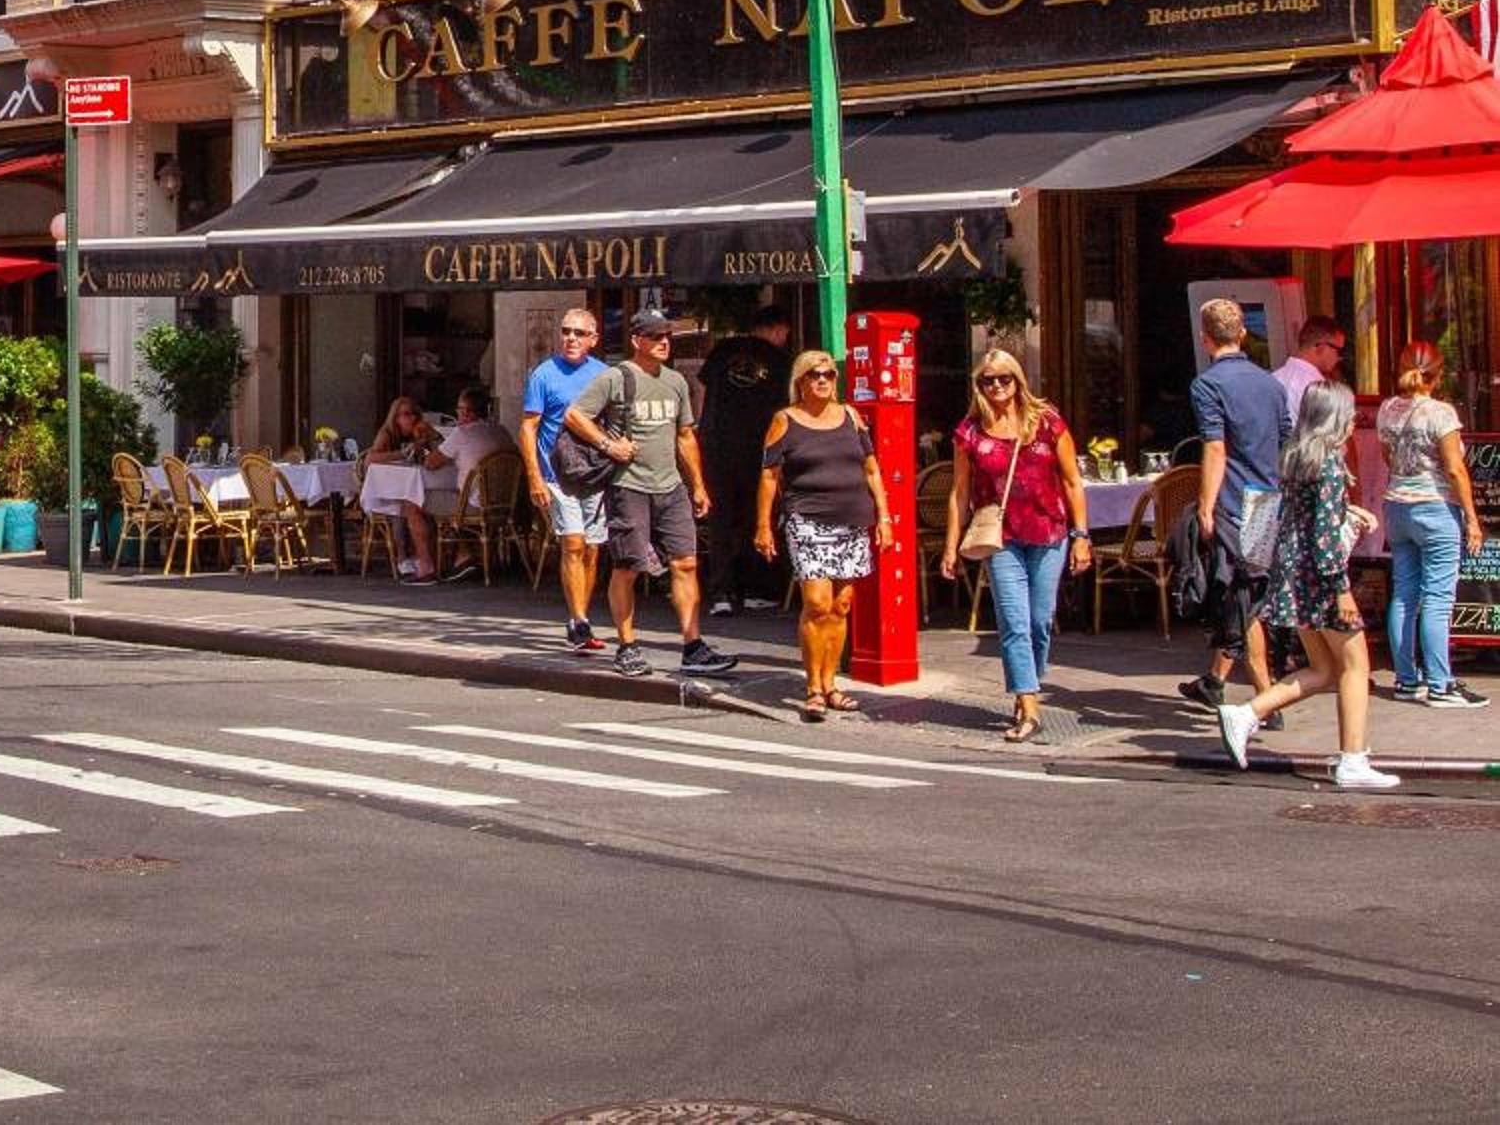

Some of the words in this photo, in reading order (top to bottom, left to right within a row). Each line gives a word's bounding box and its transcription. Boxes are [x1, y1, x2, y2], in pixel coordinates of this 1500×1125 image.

[1147, 0, 1258, 26] Ristorante
[424, 242, 527, 283] CAFFE
[533, 235, 669, 281] NAPOLI
[723, 250, 814, 275] RISTORA
[106, 271, 182, 290] RISTORANTE
